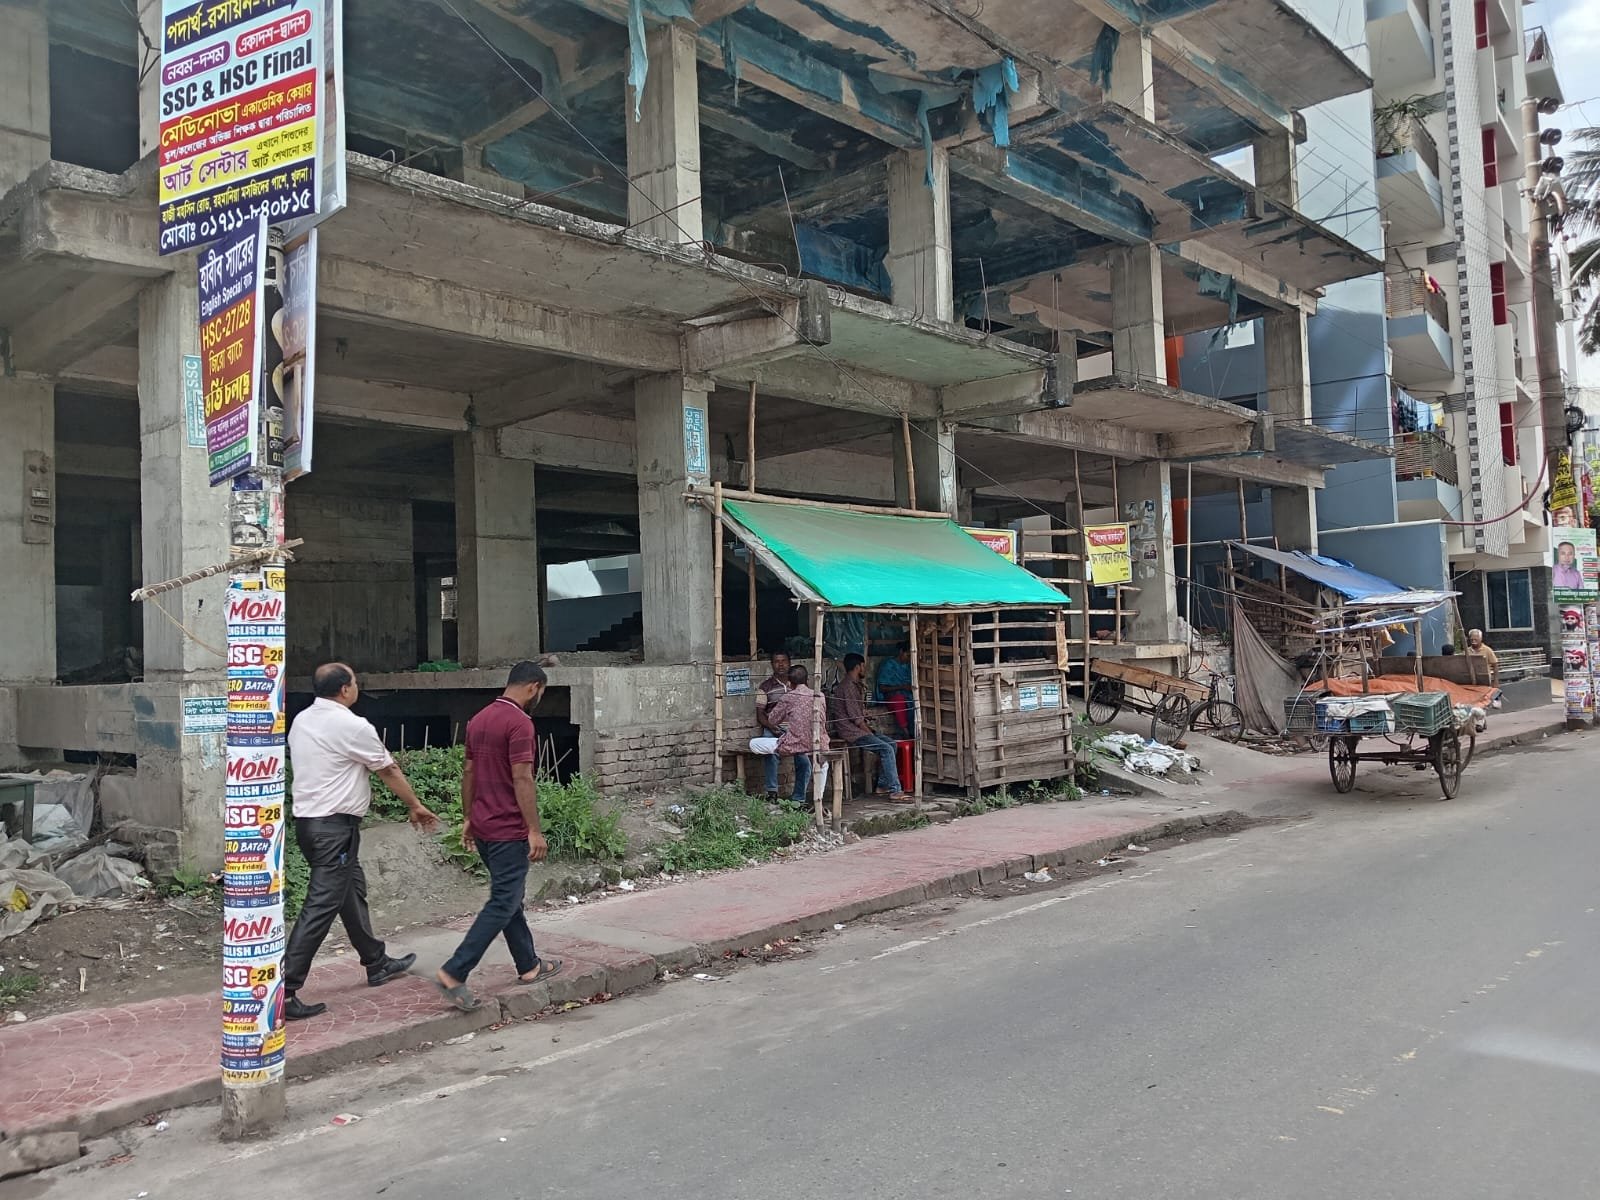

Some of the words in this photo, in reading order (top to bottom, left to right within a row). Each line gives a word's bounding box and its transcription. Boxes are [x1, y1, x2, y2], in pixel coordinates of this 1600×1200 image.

[238, 13, 307, 53] একাদশ-দ্বাদশ
[166, 45, 225, 80] নবম-দশম
[162, 81, 198, 116] SSC
[201, 80, 215, 102] &
[219, 59, 258, 95] HSC
[262, 38, 312, 80] Final
[161, 101, 240, 148] মেডিনোভা
[256, 134, 280, 150] এখানে
[251, 153, 270, 170] আর্ট
[271, 146, 300, 163] শেখানো
[163, 159, 195, 193] আর্ট
[198, 149, 250, 184] সেন্টার
[199, 248, 224, 296] হাবীব
[224, 233, 256, 278] স্যারের
[201, 291, 222, 317] English
[222, 276, 243, 305] Special
[201, 299, 251, 352] HSC-27/28
[185, 360, 198, 388] SSC
[229, 597, 282, 621] MONI
[244, 680, 273, 691] BATCH
[226, 756, 278, 781] MONI
[259, 807, 281, 821] -28
[240, 842, 269, 852] BATCH
[223, 916, 272, 941] MONI
[251, 967, 276, 982] -28
[233, 1003, 261, 1013] BATCH
